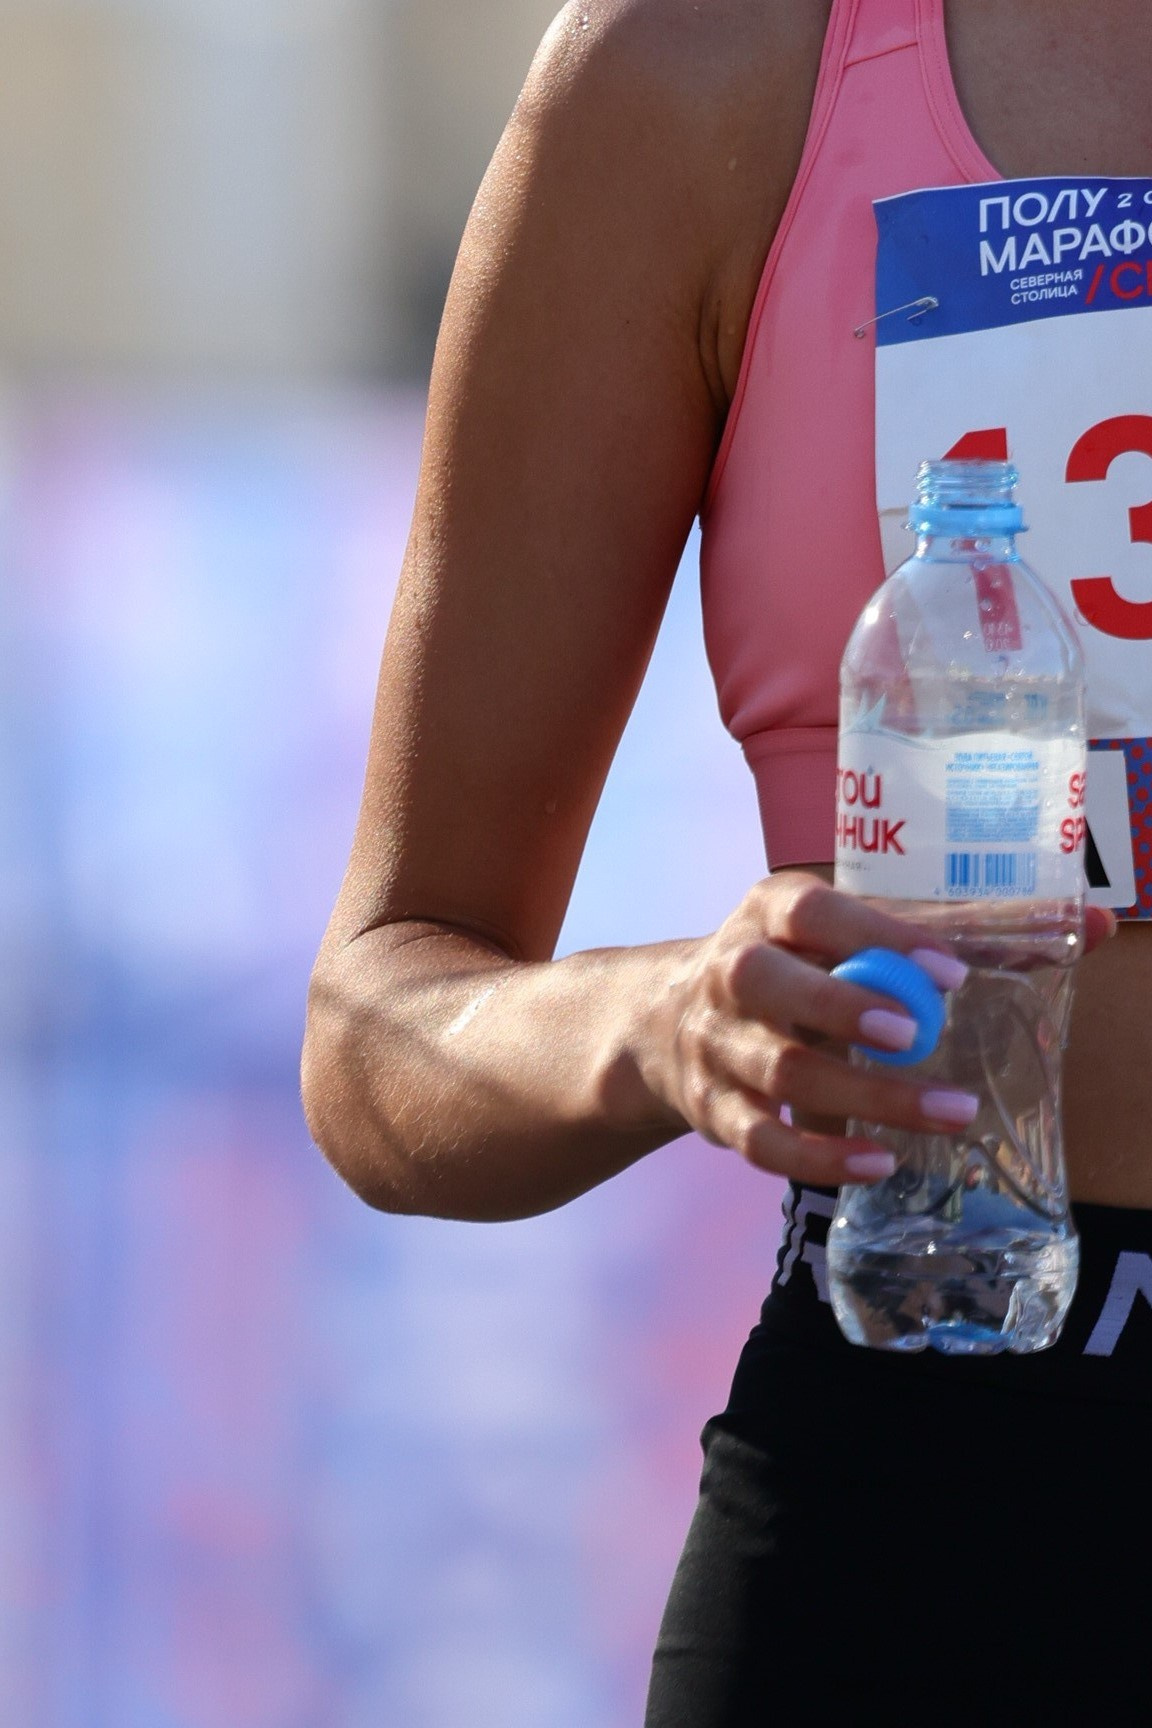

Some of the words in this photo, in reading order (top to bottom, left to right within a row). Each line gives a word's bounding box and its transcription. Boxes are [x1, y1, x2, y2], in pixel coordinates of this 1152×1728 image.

[979, 187, 1108, 233] ПОЛУ
[1010, 268, 1084, 291] СЕВЕРНАЯ
[1011, 284, 1079, 305] СТОЛИЦА
